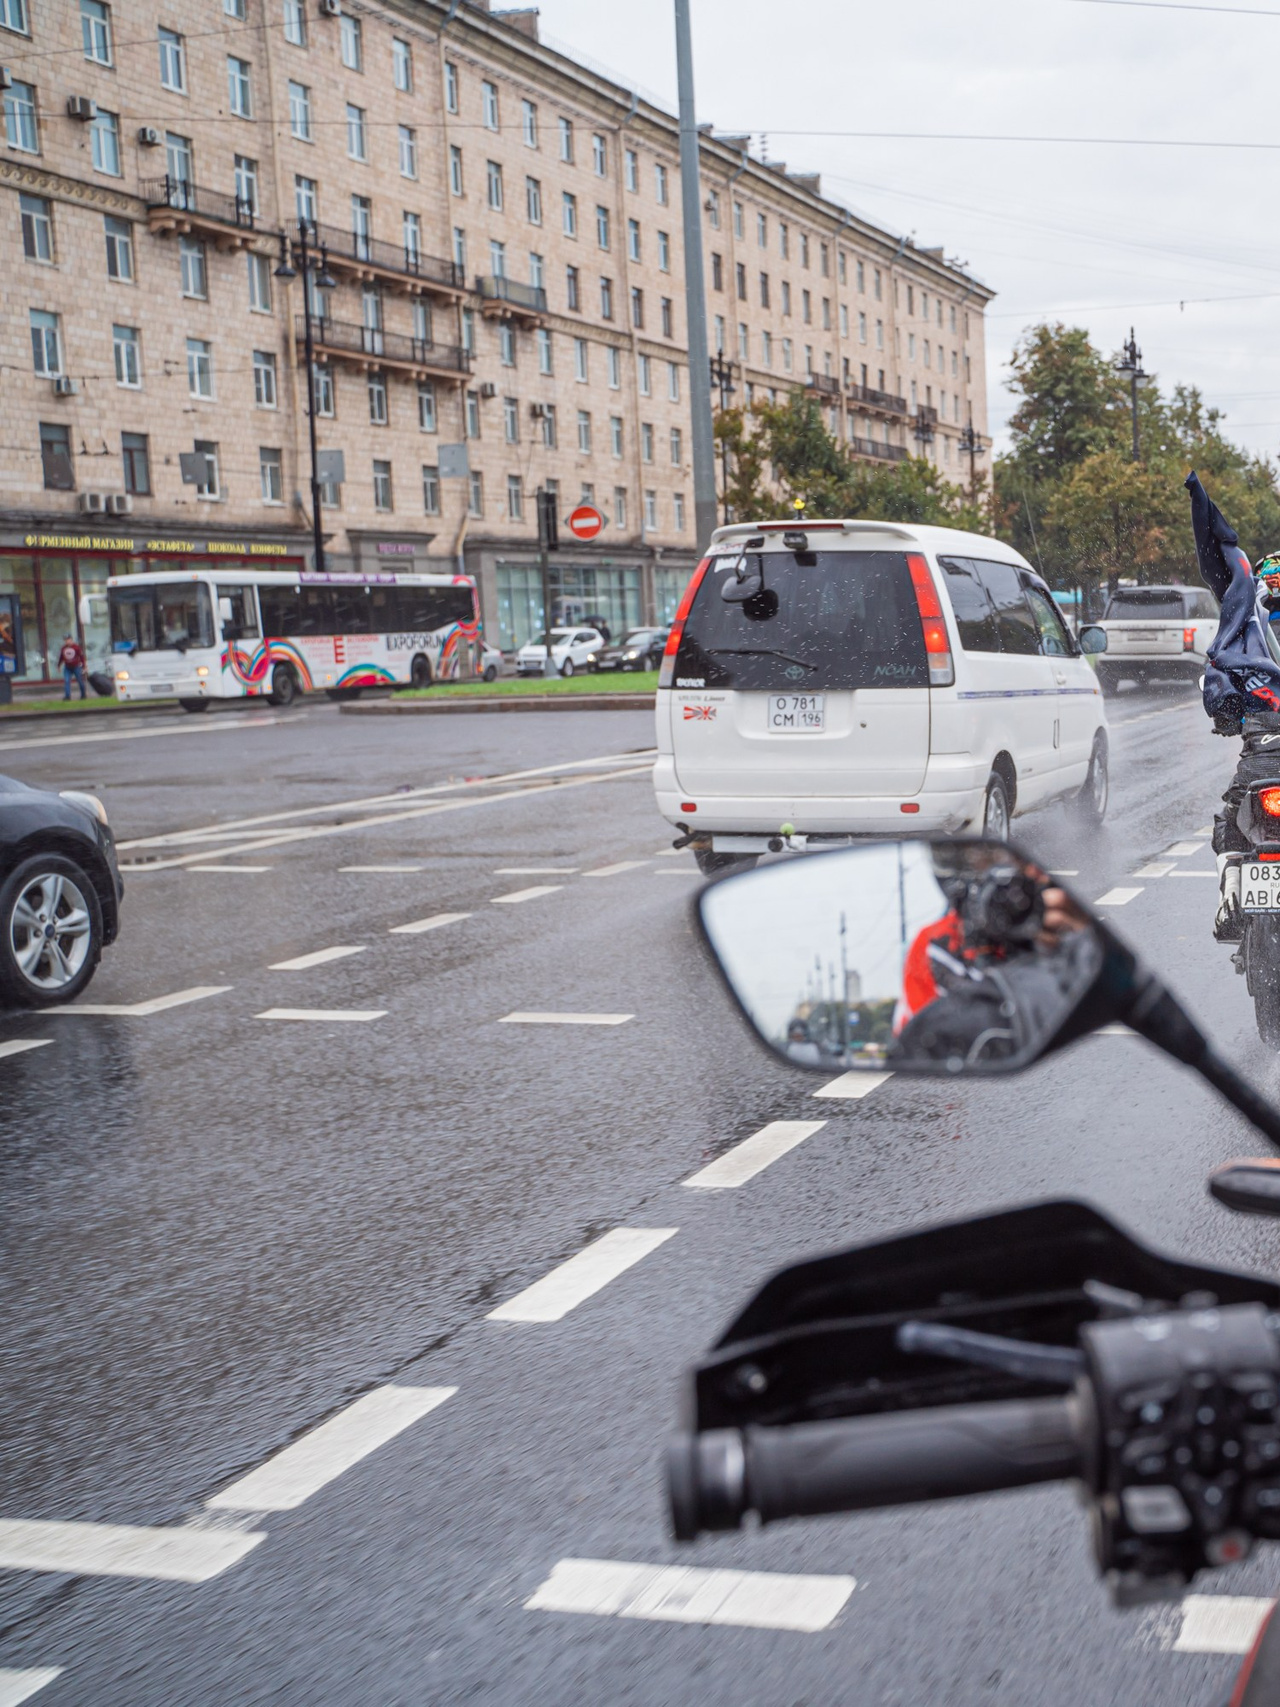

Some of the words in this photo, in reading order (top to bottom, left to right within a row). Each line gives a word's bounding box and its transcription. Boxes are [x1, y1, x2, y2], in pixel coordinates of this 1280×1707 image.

[91, 537, 134, 550] МАГАЗИН
[873, 665, 917, 676] NOAH
[792, 697, 816, 710] 781
[802, 713, 821, 724] 196
